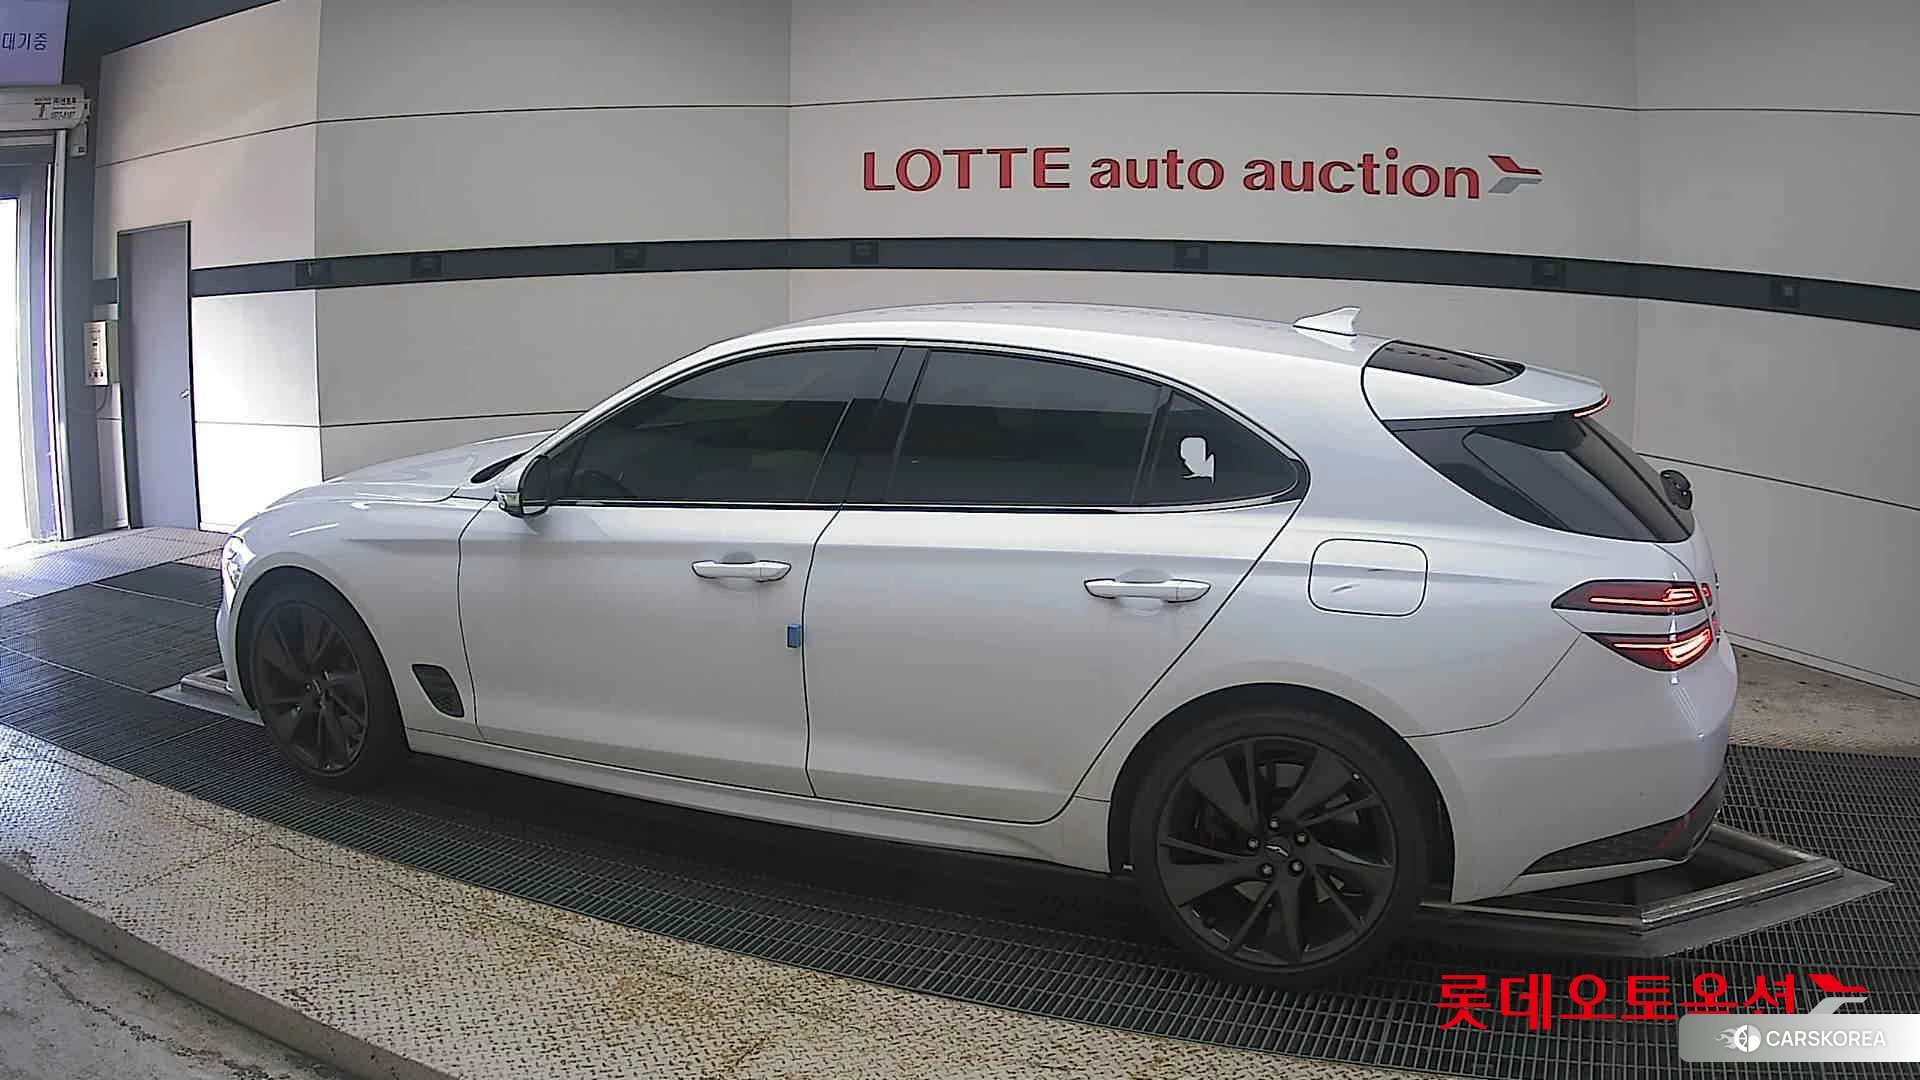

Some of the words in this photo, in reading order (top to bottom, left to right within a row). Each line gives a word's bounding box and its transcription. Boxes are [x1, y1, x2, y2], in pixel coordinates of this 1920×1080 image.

[2, 32, 48, 51] 대기중
[863, 147, 1071, 191] LOTTE
[1090, 151, 1225, 190] auto
[1242, 149, 1480, 199] auction
